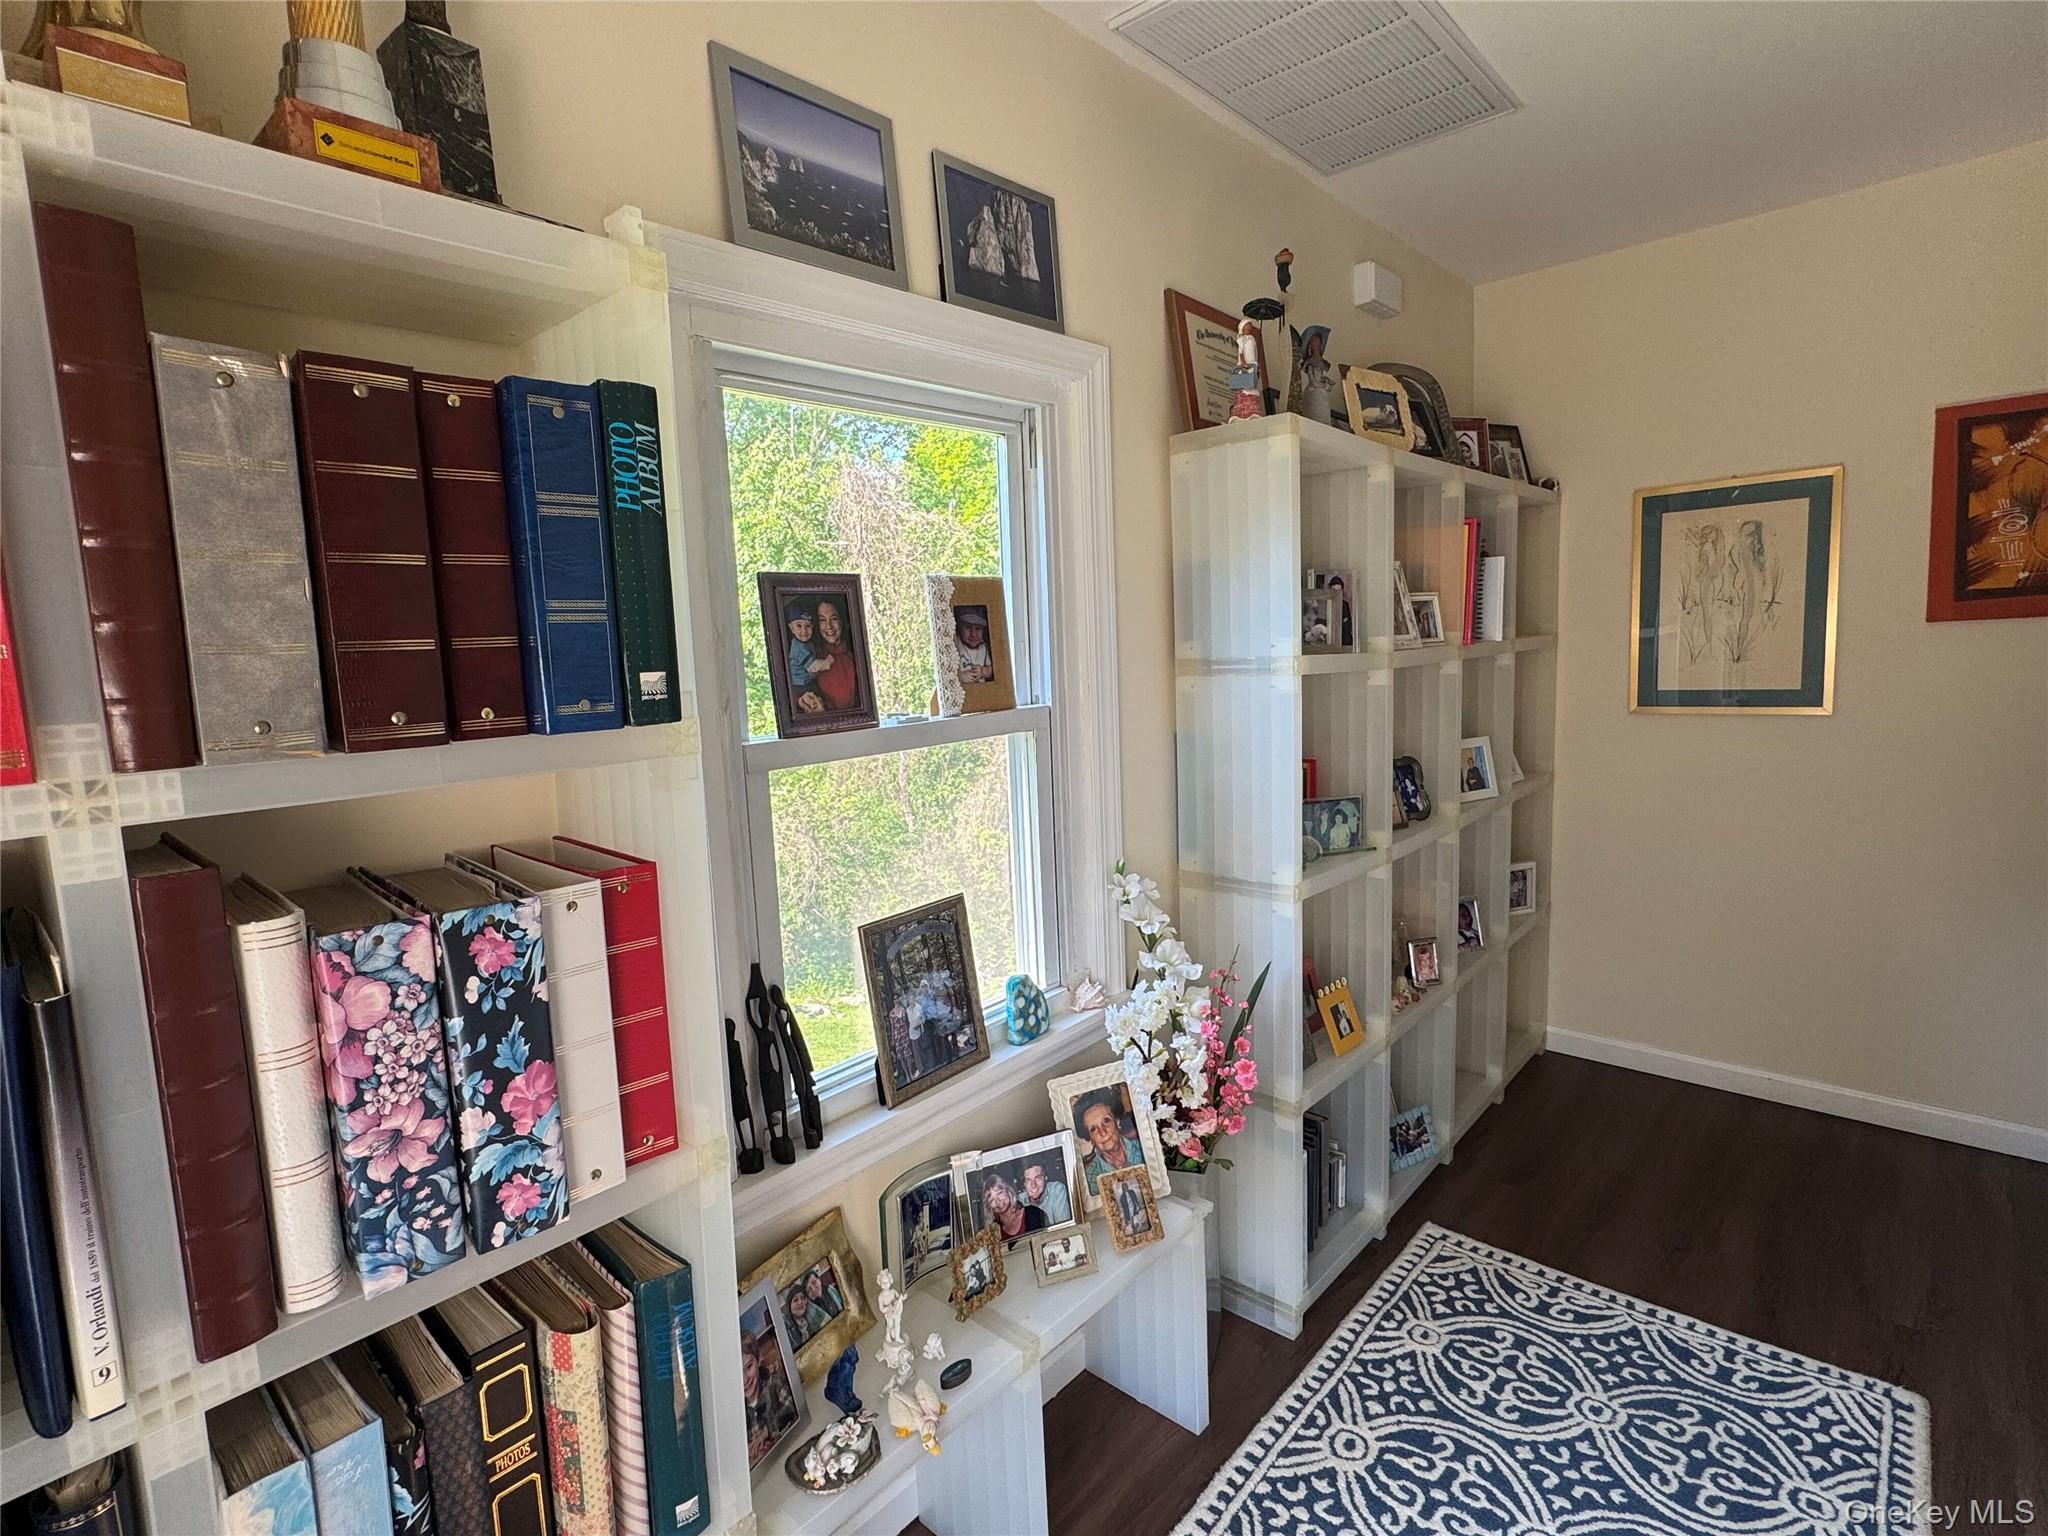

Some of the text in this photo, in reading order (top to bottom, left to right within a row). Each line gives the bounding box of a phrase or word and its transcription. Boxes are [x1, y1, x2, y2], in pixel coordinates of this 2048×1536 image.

[608, 421, 642, 513] PHOTO
[634, 420, 663, 517] ALBUM
[85, 1285, 109, 1341] Orlandi
[93, 1341, 110, 1358] V.
[98, 1366, 111, 1384] 9
[495, 1442, 532, 1473] PHOTOS
